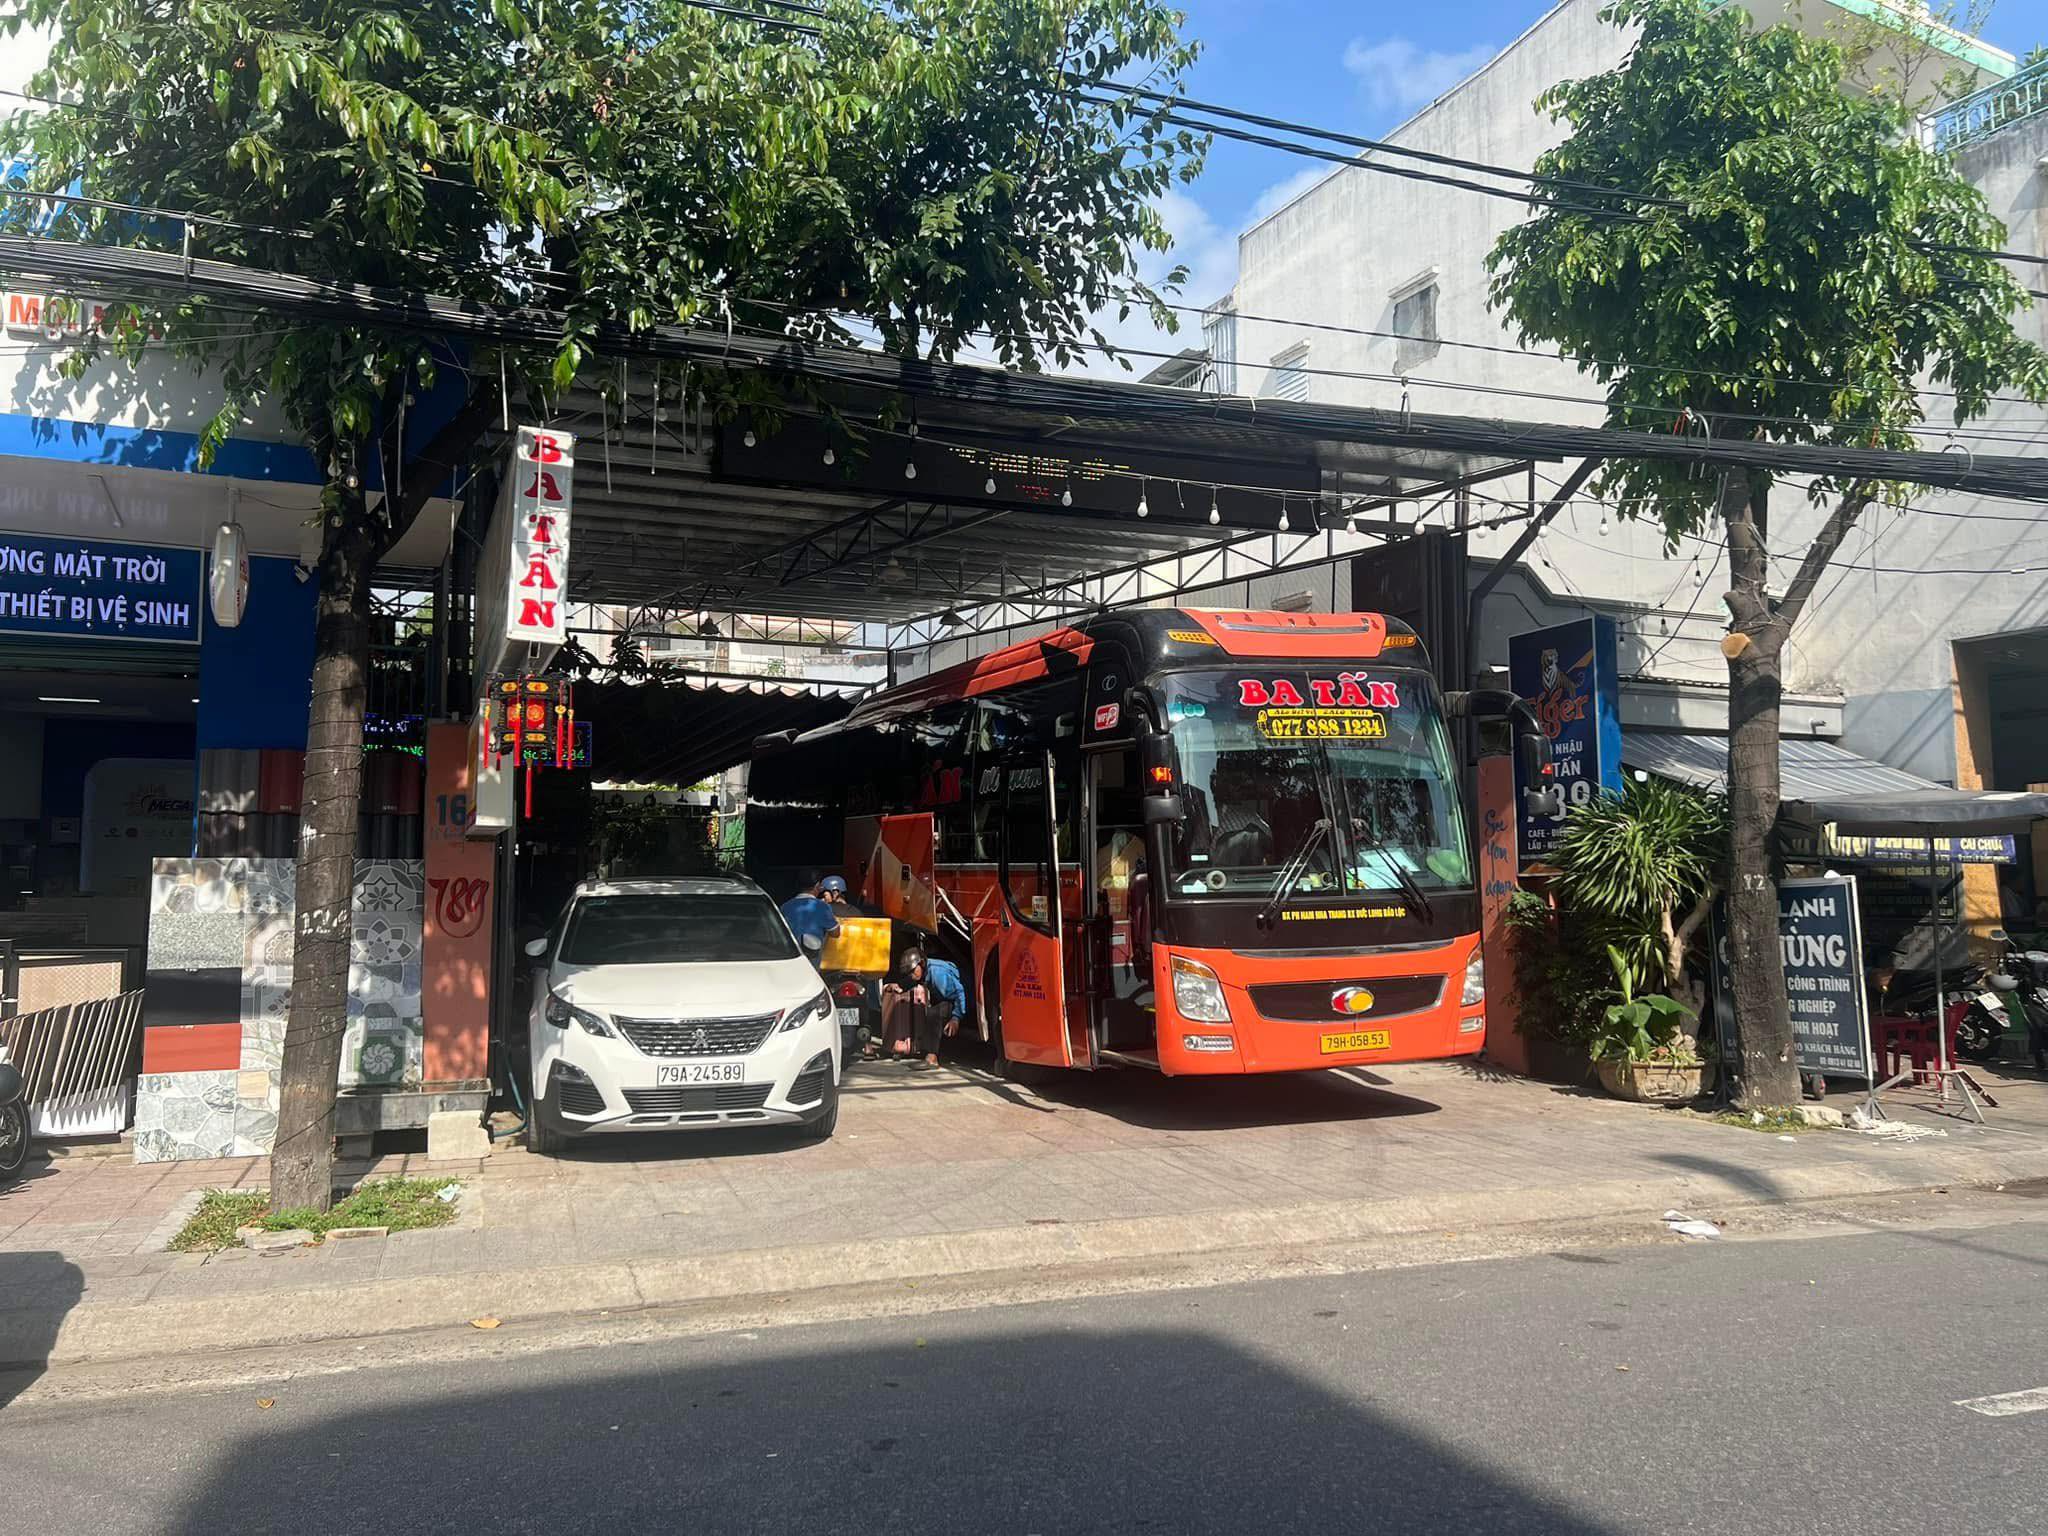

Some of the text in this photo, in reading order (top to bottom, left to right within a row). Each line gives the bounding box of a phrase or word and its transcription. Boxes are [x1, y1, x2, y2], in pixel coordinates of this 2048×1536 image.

[53, 549, 106, 585] MẶT
[112, 554, 167, 583] TRỜI
[0, 587, 190, 629] THIẾT BỊ VỆ SINH
[1238, 672, 1400, 708] BA TẤN
[1555, 740, 1583, 755] NHẬU
[1553, 757, 1581, 777] TẤN
[1787, 974, 1850, 992] CÔNG TRÌNH
[1797, 998, 1836, 1017] NGHIỆP
[1812, 1022, 1839, 1039] HOẠT
[660, 1064, 742, 1082] 79A-245.89
